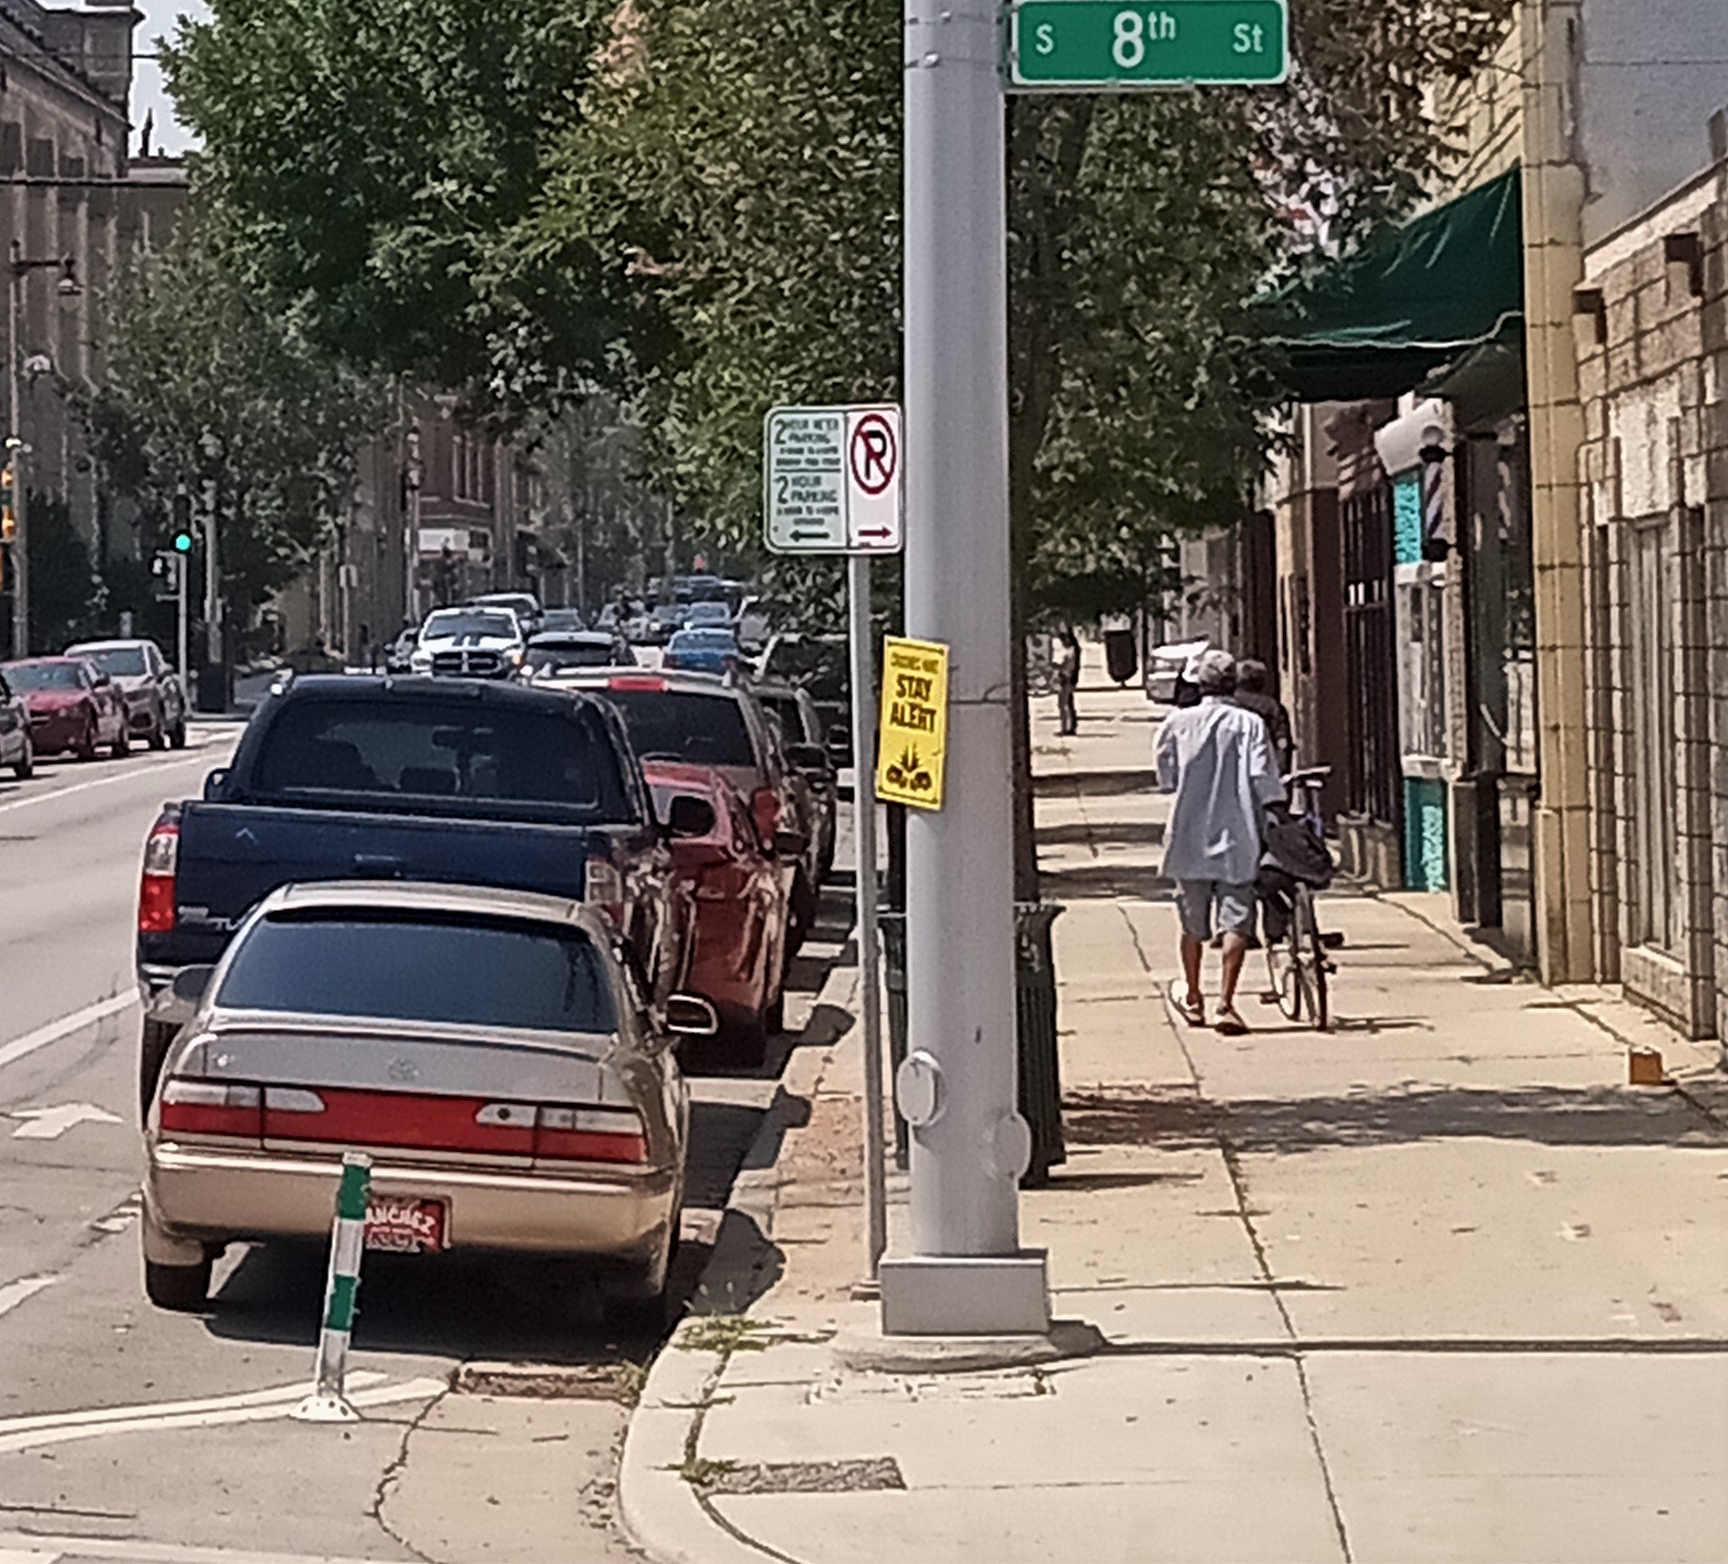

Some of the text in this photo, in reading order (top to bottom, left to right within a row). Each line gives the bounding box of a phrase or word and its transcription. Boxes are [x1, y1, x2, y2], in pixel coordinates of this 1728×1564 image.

[1036, 10, 1263, 68] S 8th St
[774, 418, 786, 444] 2
[773, 475, 789, 504] 2
[896, 673, 933, 702] STAY
[889, 701, 937, 734] ALERT
